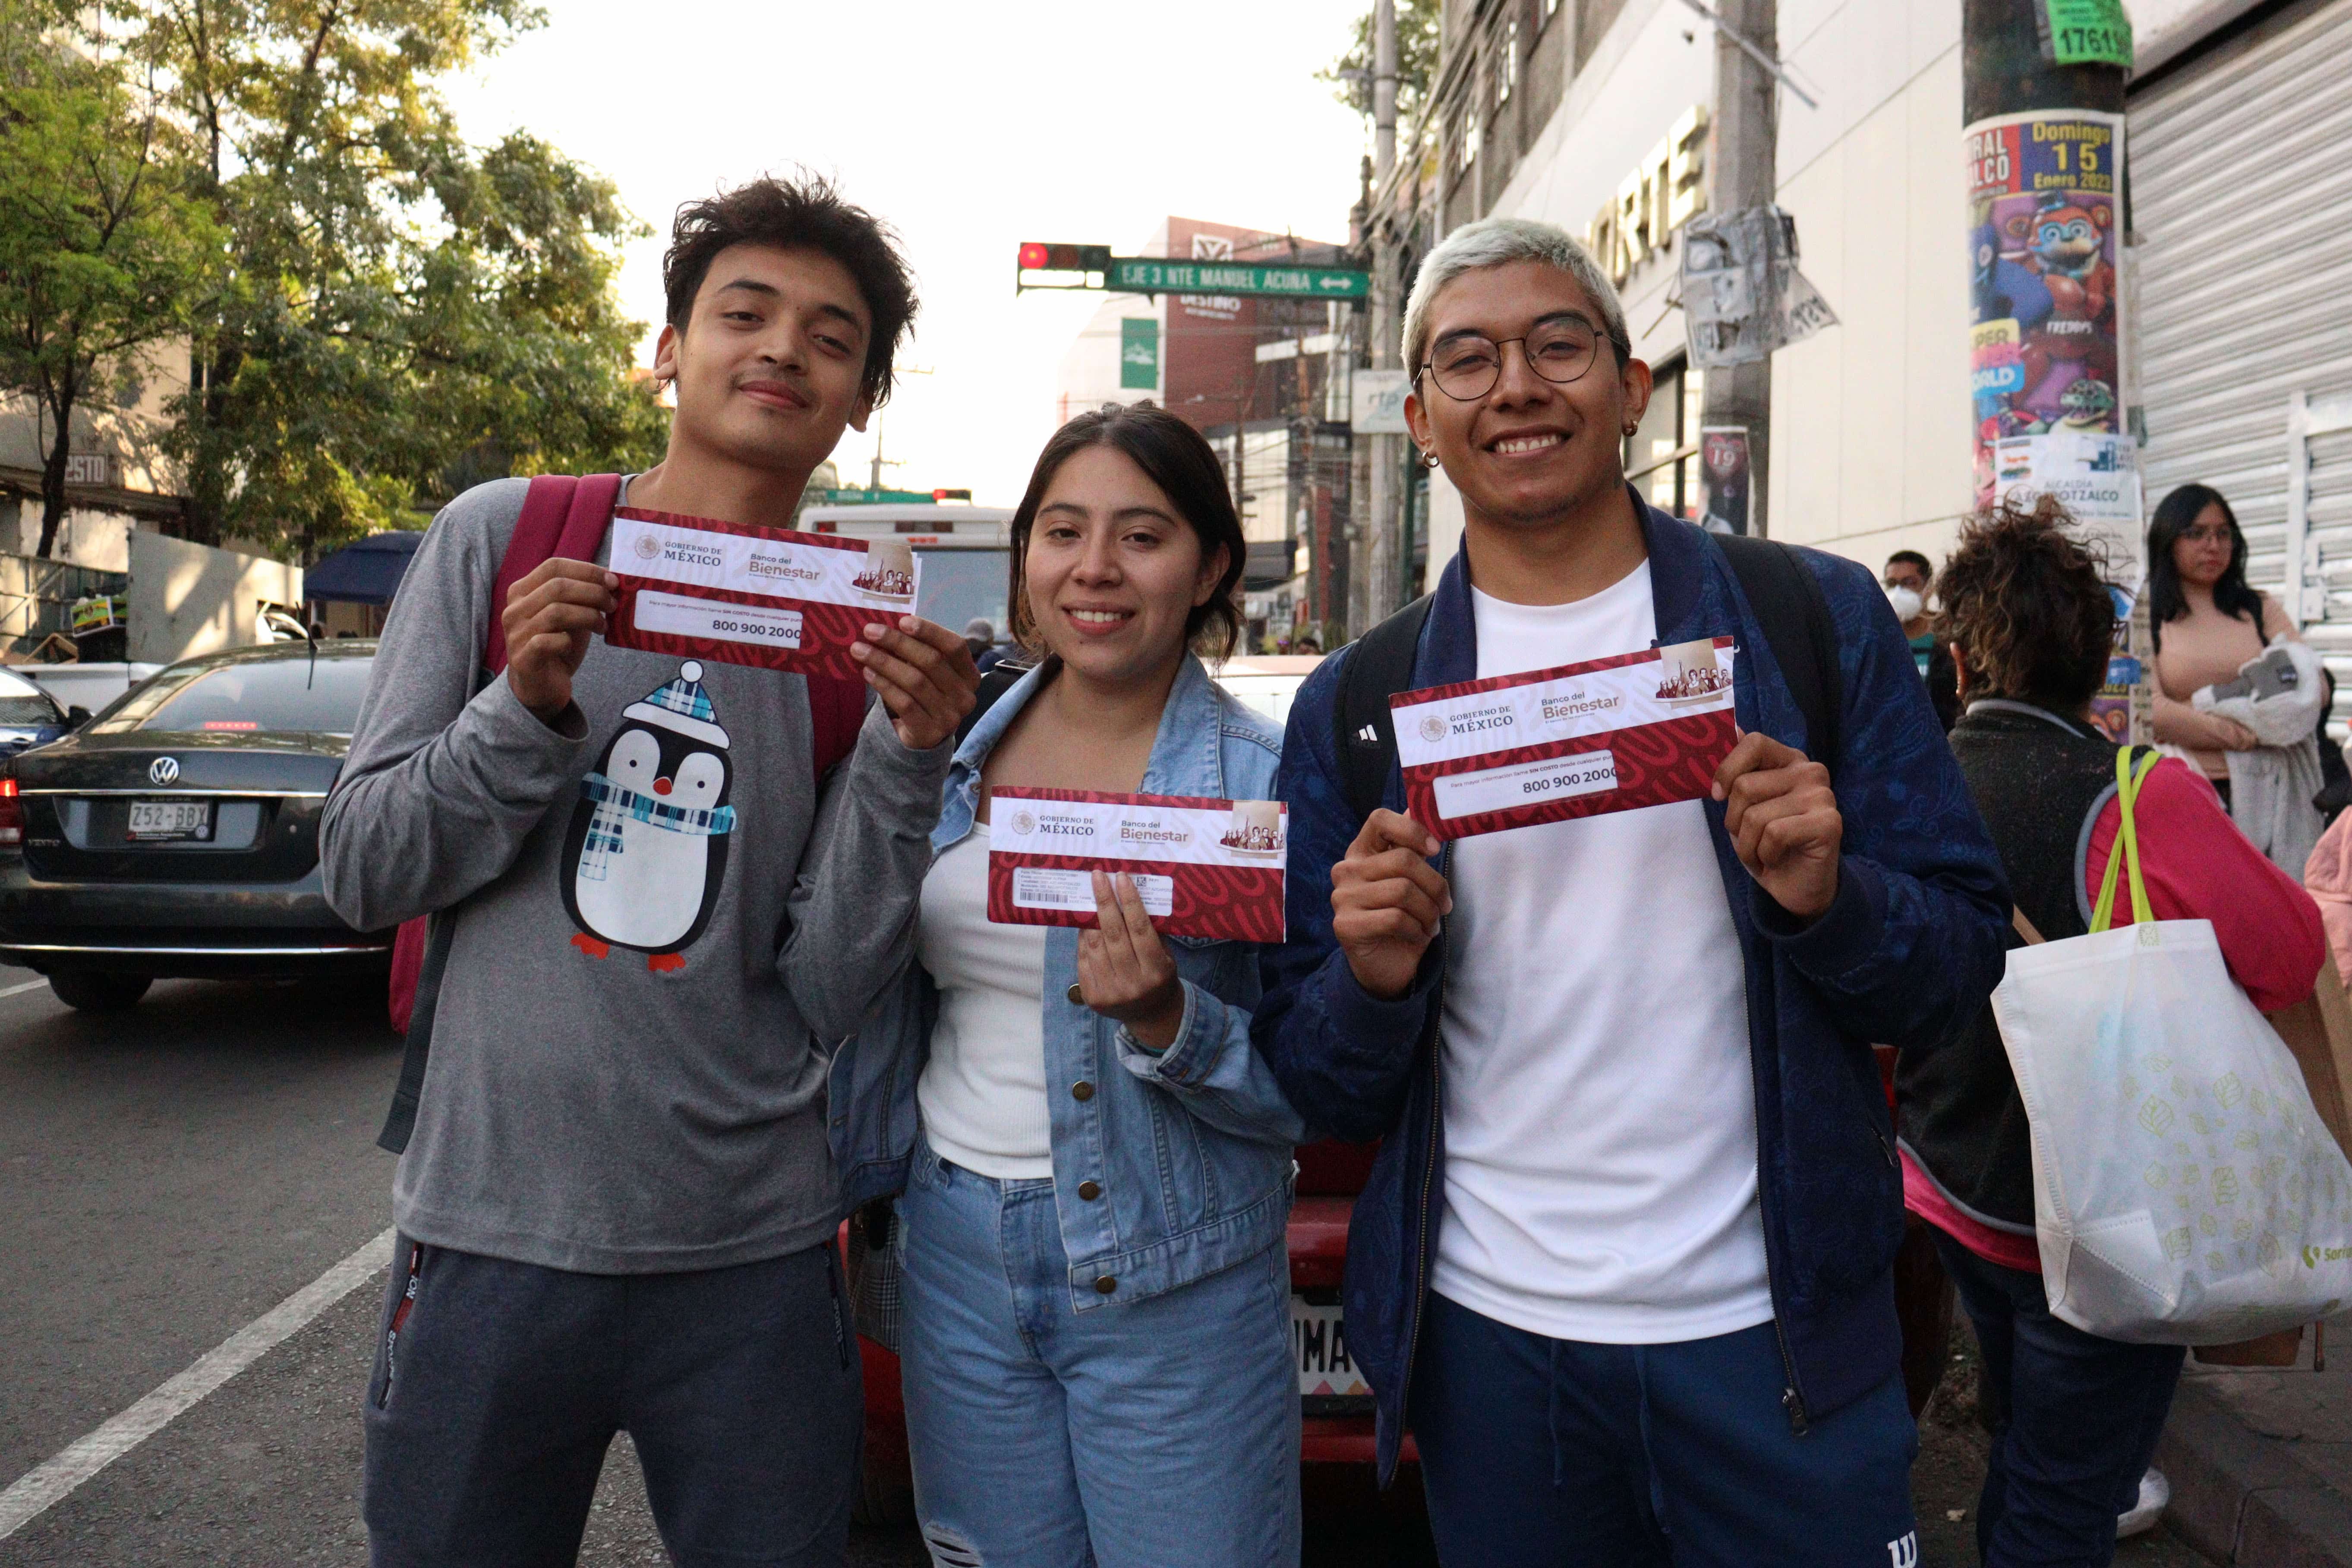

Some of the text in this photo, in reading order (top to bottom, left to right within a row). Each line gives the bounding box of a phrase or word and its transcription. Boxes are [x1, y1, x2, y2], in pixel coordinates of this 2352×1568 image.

[2032, 121, 2111, 146] Domingo
[2034, 172, 2111, 189] Enero 2023
[1585, 105, 1707, 284] ORTE
[1122, 265, 1145, 284] EJE
[1152, 267, 1161, 285] 3
[1167, 267, 1194, 286] NTE
[1200, 268, 1256, 288] MANUEL
[665, 541, 709, 553] GOBIERNO
[664, 549, 721, 566] MÉXICO
[751, 554, 776, 562] Banco
[749, 562, 820, 581] Bienestar
[713, 620, 801, 639] 800 900 2000
[1542, 695, 1569, 706] Banco
[1543, 696, 1619, 719] Bienestar
[1450, 705, 1511, 722] GOBIERNO DE
[1452, 716, 1513, 735] MÉXICO
[1577, 757, 1601, 765] cualquier
[1523, 779, 1550, 793] 800
[1553, 774, 1580, 788] 900
[1040, 815, 1081, 823] GOBIERNO
[1040, 823, 1094, 836] MÉXICO
[1121, 828, 1188, 842] Bienestar
[1295, 1319, 1350, 1373] MA
